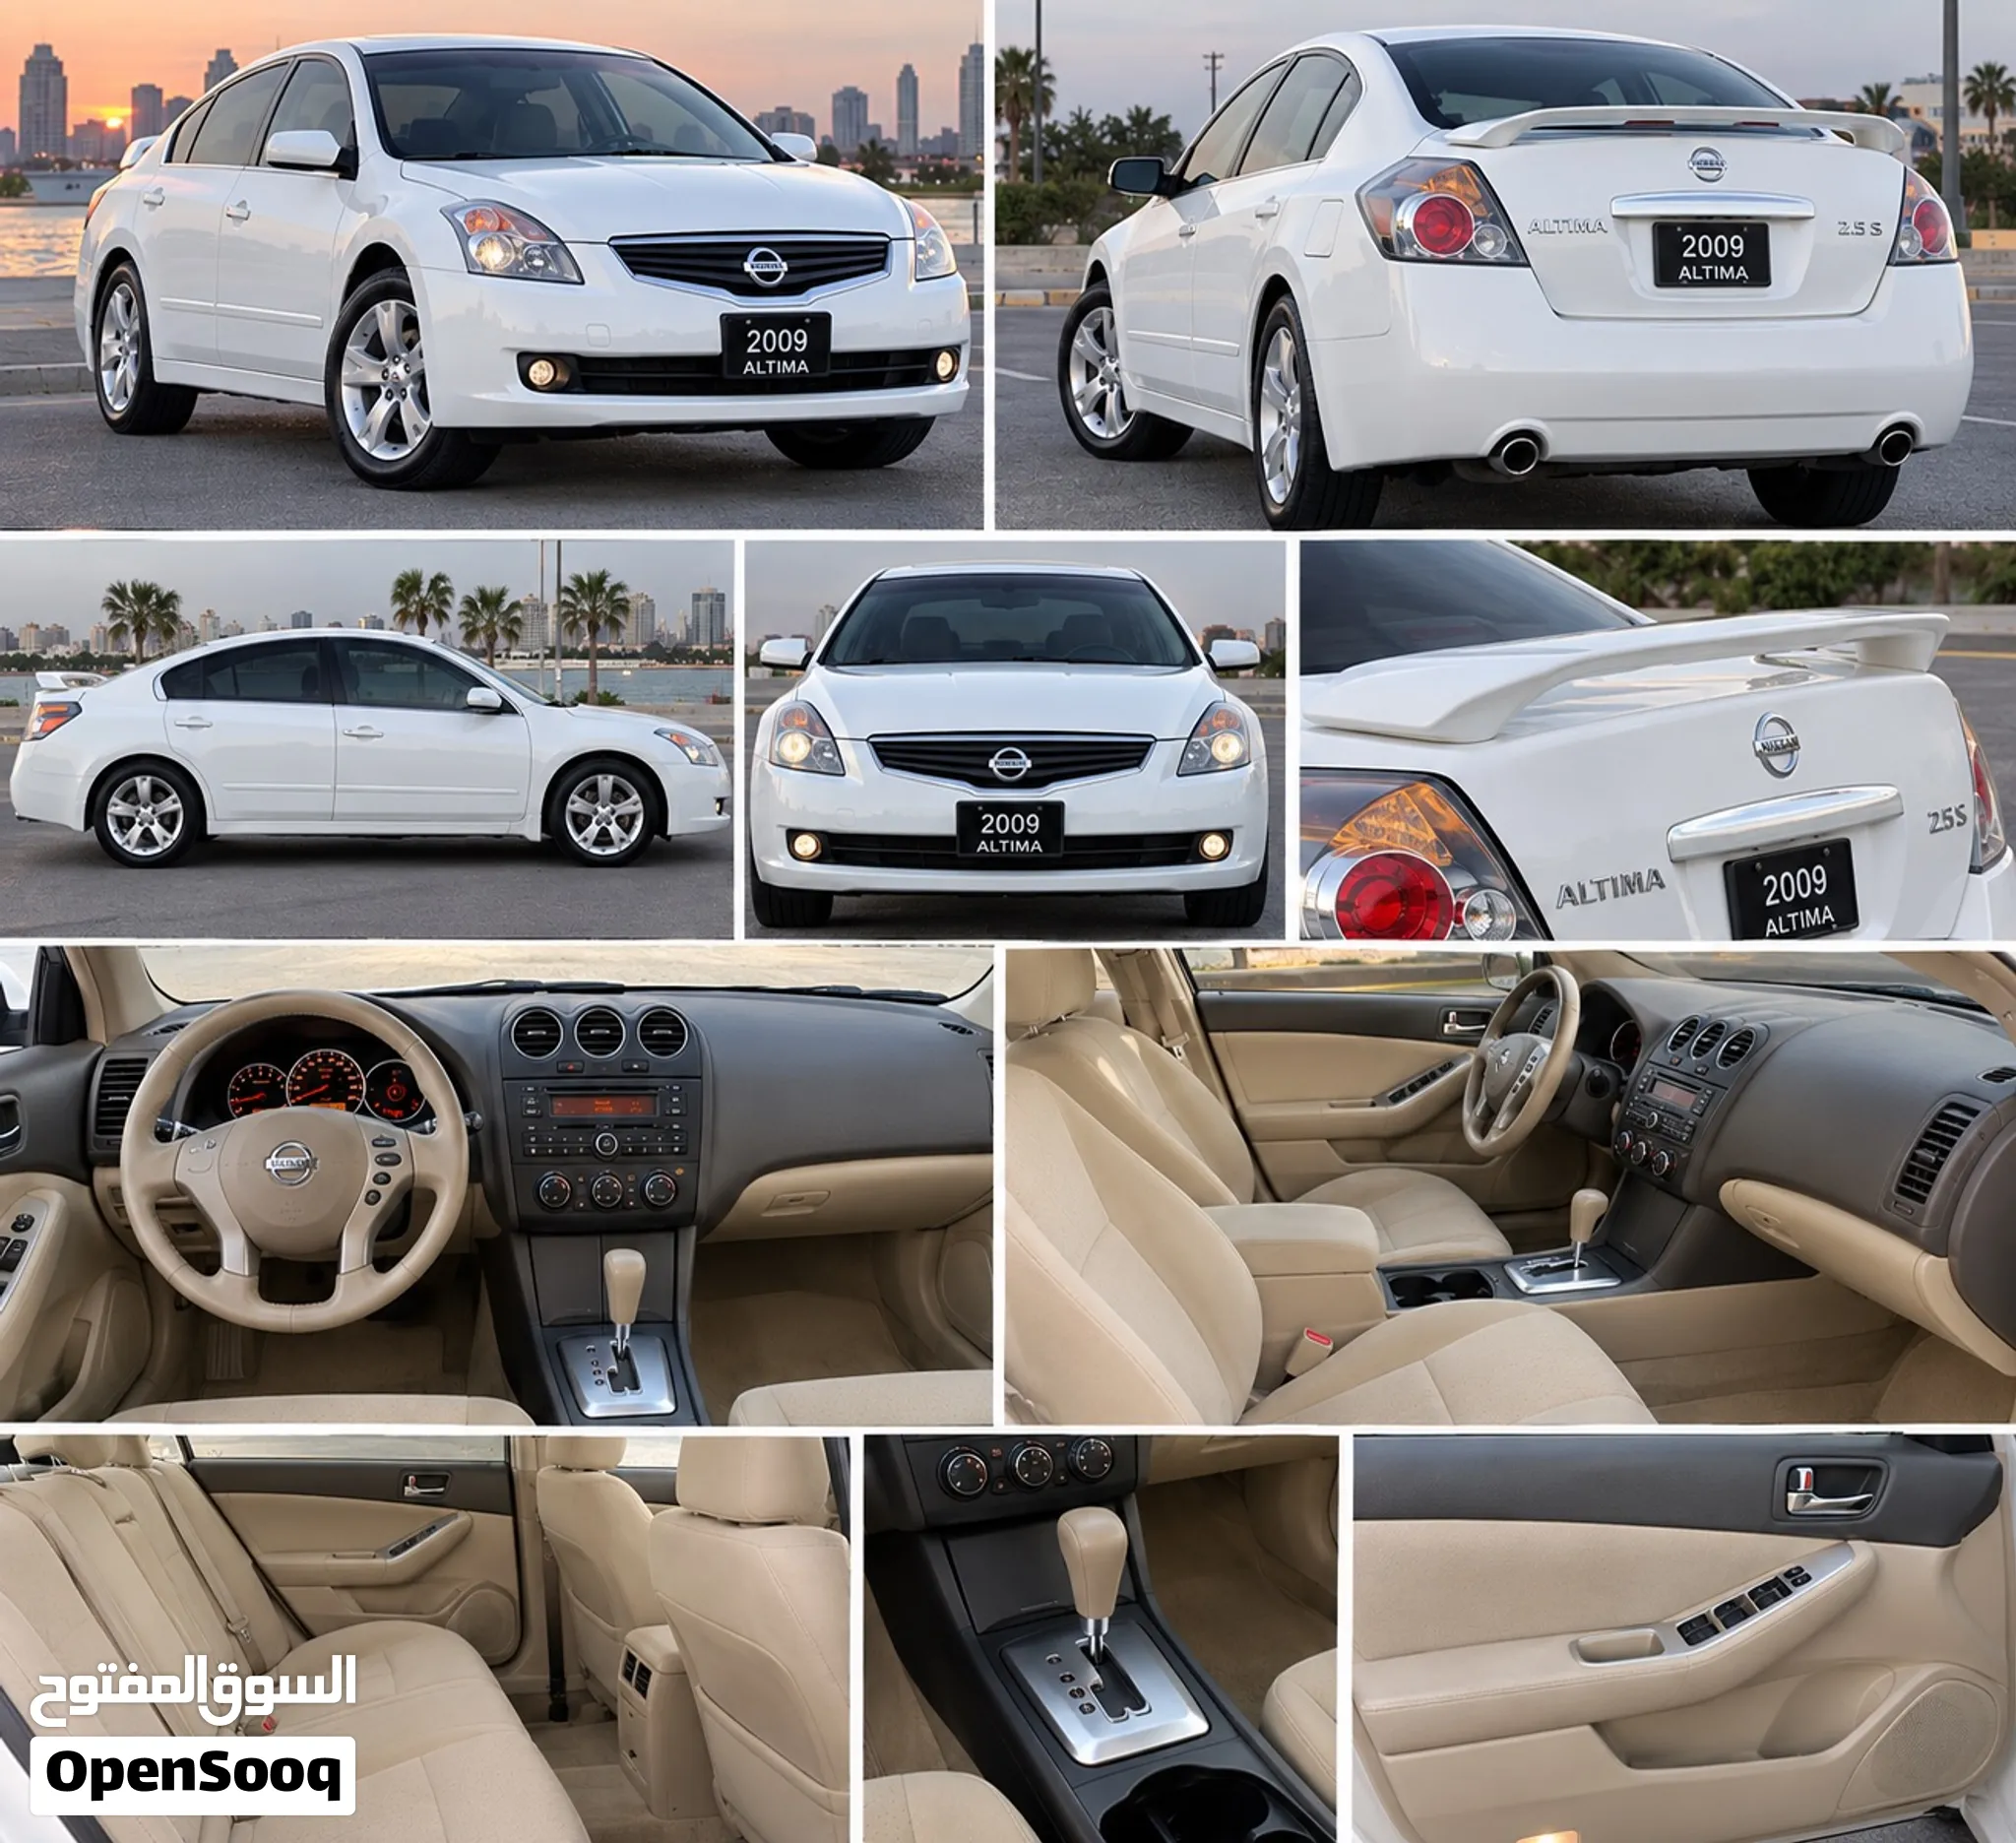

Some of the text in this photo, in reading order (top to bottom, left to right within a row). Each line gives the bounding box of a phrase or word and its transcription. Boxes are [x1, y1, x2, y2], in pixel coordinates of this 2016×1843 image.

[1681, 234, 1744, 258] 2009
[1678, 265, 1749, 280] ALTIMA
[746, 329, 808, 353] 2009
[742, 359, 810, 375] ALTIMA
[980, 813, 1040, 835] 2009
[976, 840, 1043, 854] ALTIMA
[1555, 867, 1667, 910] ALTIMA
[1762, 864, 1827, 907] 2009
[1765, 905, 1835, 937] ALTIMA
